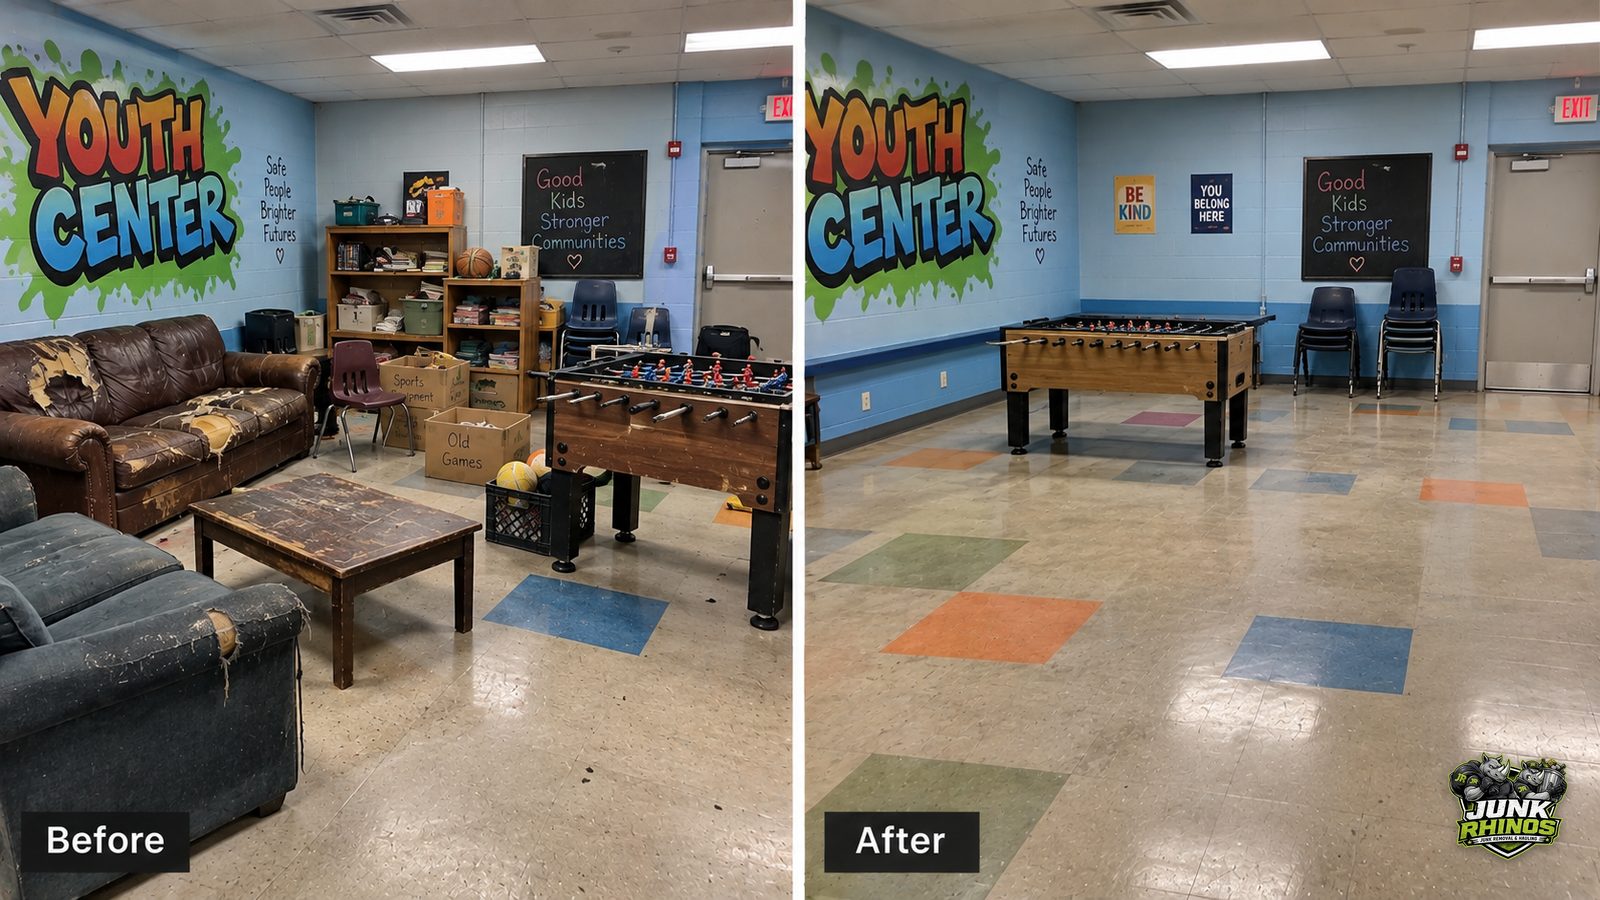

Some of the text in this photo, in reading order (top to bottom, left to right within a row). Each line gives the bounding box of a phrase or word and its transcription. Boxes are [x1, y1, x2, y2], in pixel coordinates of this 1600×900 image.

[1562, 97, 1592, 118] EXIT
[2, 69, 205, 183] YOUTH
[805, 84, 966, 189] YOUTH
[266, 155, 287, 177] Safe
[1026, 156, 1047, 178] Safe
[536, 166, 583, 189] Good
[1317, 169, 1365, 192] Good
[264, 177, 292, 202] People
[1024, 178, 1052, 202] People
[1125, 186, 1144, 203] BE
[1200, 184, 1222, 197] YOU
[551, 191, 585, 210] Kids
[1194, 198, 1230, 209] BELONG
[1332, 193, 1367, 213] Kids
[260, 200, 296, 225] Brighter
[1020, 200, 1057, 225] Brighter
[1119, 204, 1152, 220] KIND
[1199, 210, 1225, 222] HERE
[31, 172, 236, 279] CENTER
[263, 224, 296, 242] Futures
[540, 212, 609, 234] Stronger
[806, 173, 996, 281] CENTER
[1022, 224, 1057, 242] Futures
[1321, 215, 1392, 237] Stronger
[532, 232, 626, 250] Communities
[393, 374, 424, 389] Sports
[448, 432, 470, 448] Old
[442, 452, 482, 469] Games
